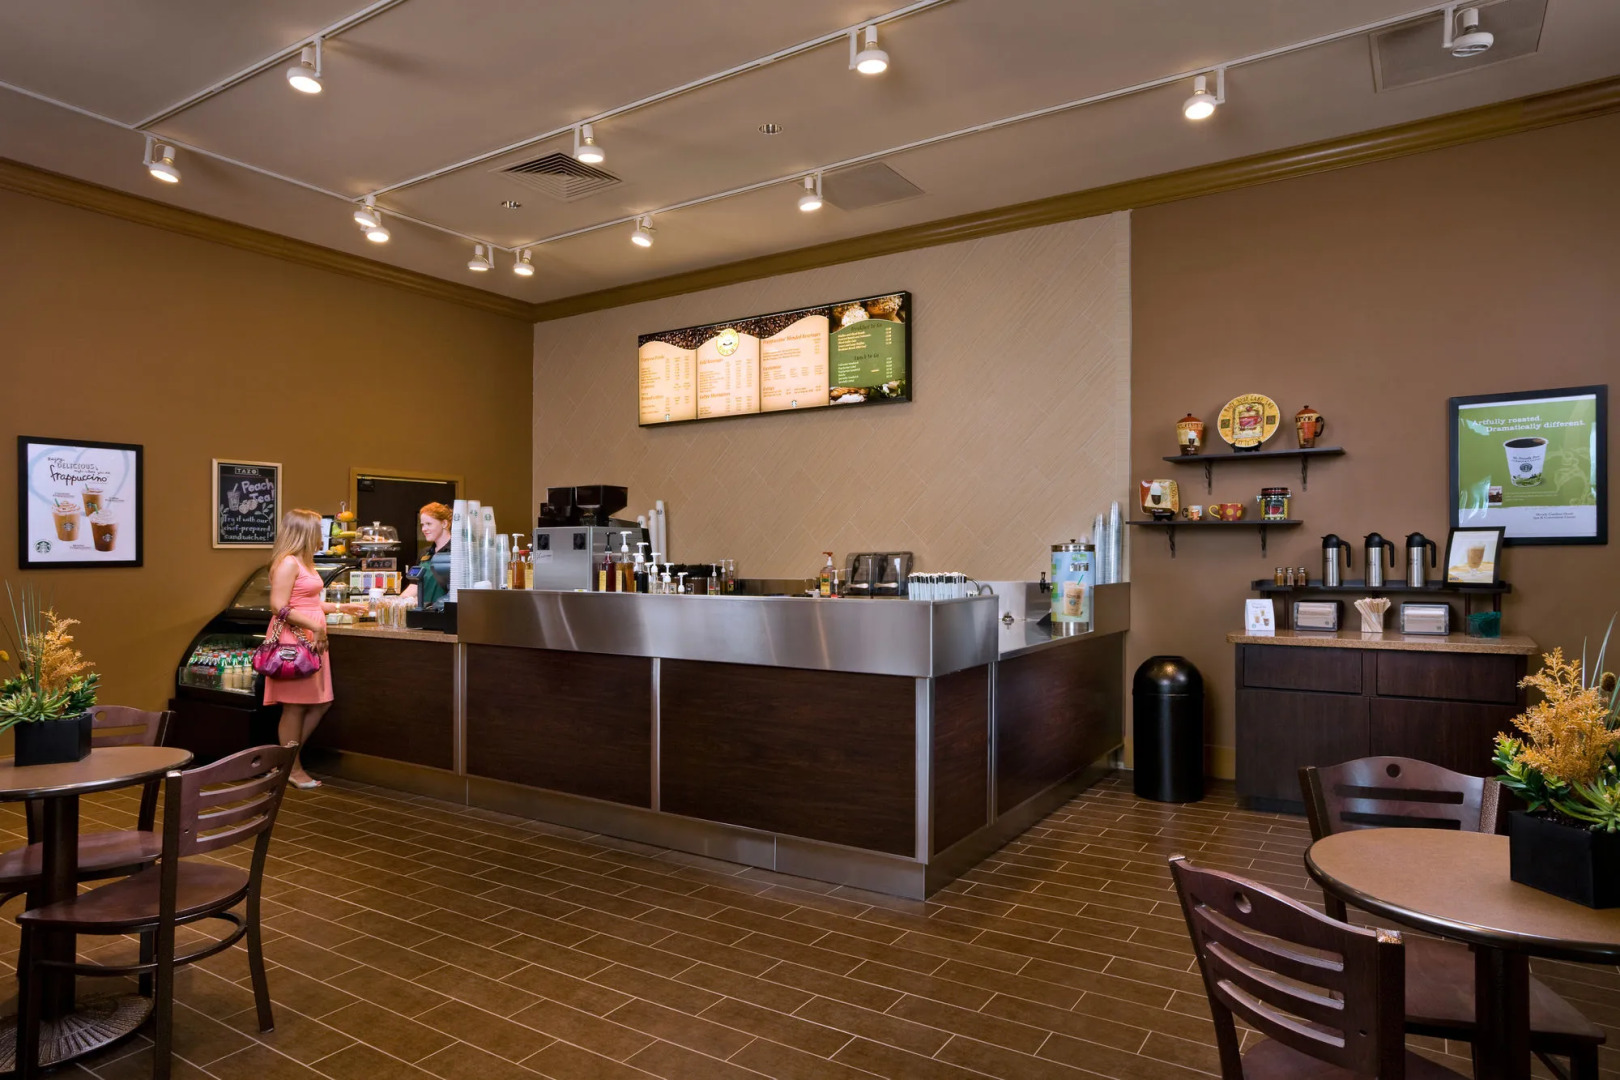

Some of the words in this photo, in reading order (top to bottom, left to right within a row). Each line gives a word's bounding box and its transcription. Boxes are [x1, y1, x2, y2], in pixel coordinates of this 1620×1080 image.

[1472, 418, 1506, 426] Artfully
[1485, 423, 1541, 433] Dramatically
[49, 464, 108, 486] frappuccino
[241, 478, 274, 494] Peach
[249, 490, 275, 503] Tea!
[223, 514, 235, 525] Try
[242, 515, 256, 523] with
[223, 524, 271, 534] chef-prepared
[223, 532, 270, 541] sandwiches!
[369, 560, 392, 568] TAZO
